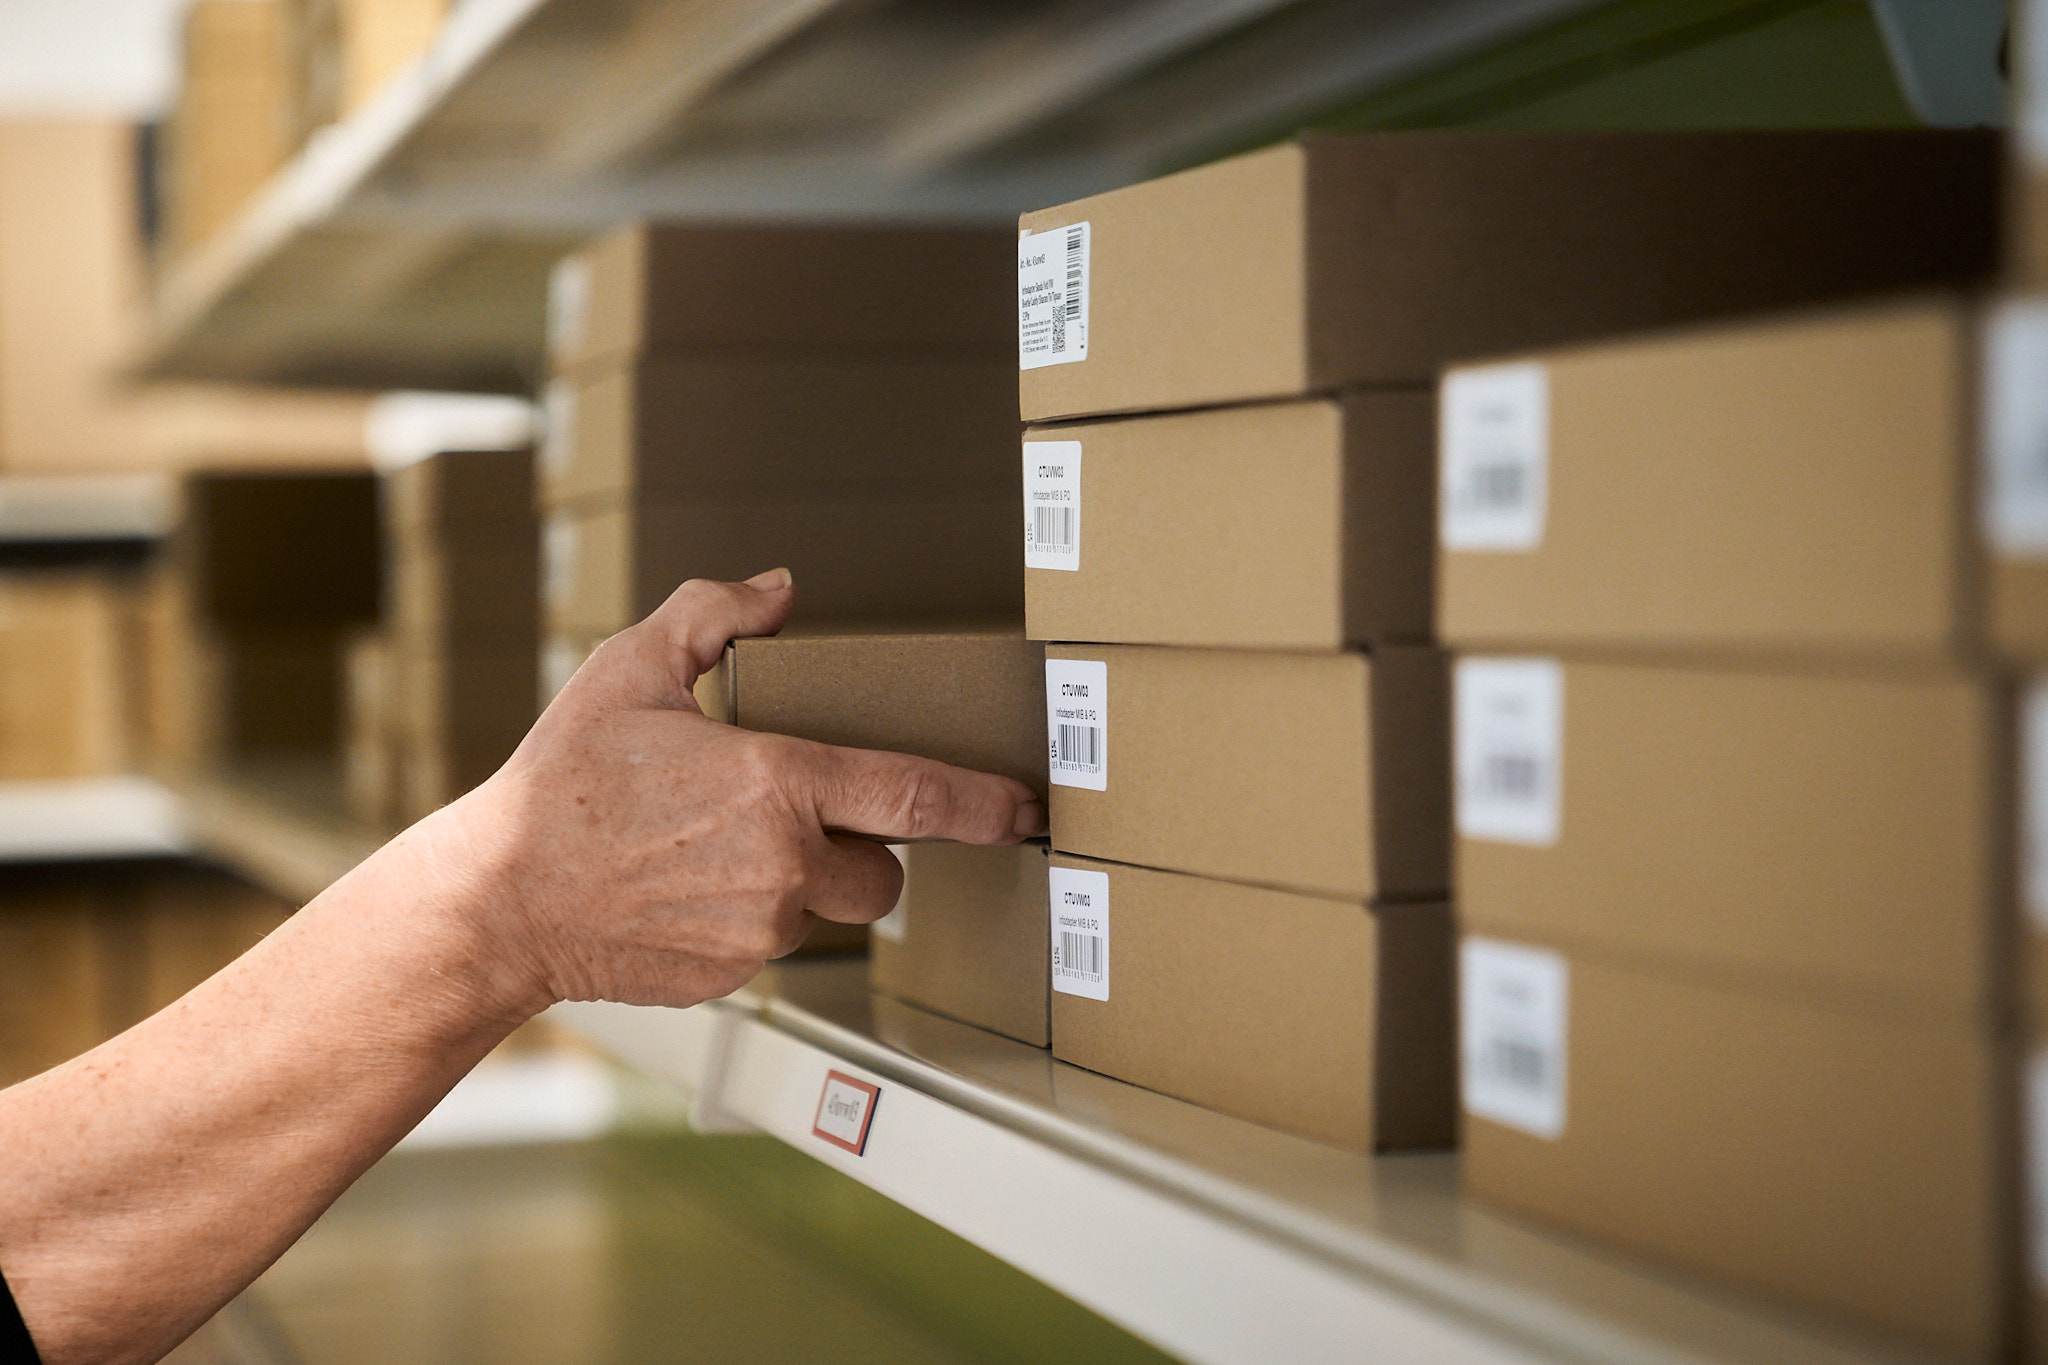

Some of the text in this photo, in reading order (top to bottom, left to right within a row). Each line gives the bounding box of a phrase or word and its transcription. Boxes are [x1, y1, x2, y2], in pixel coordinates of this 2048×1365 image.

[1039, 466, 1064, 478] CTUVW03
[1062, 684, 1088, 697] CTUVW03
[1064, 892, 1090, 907] CTUVW03
